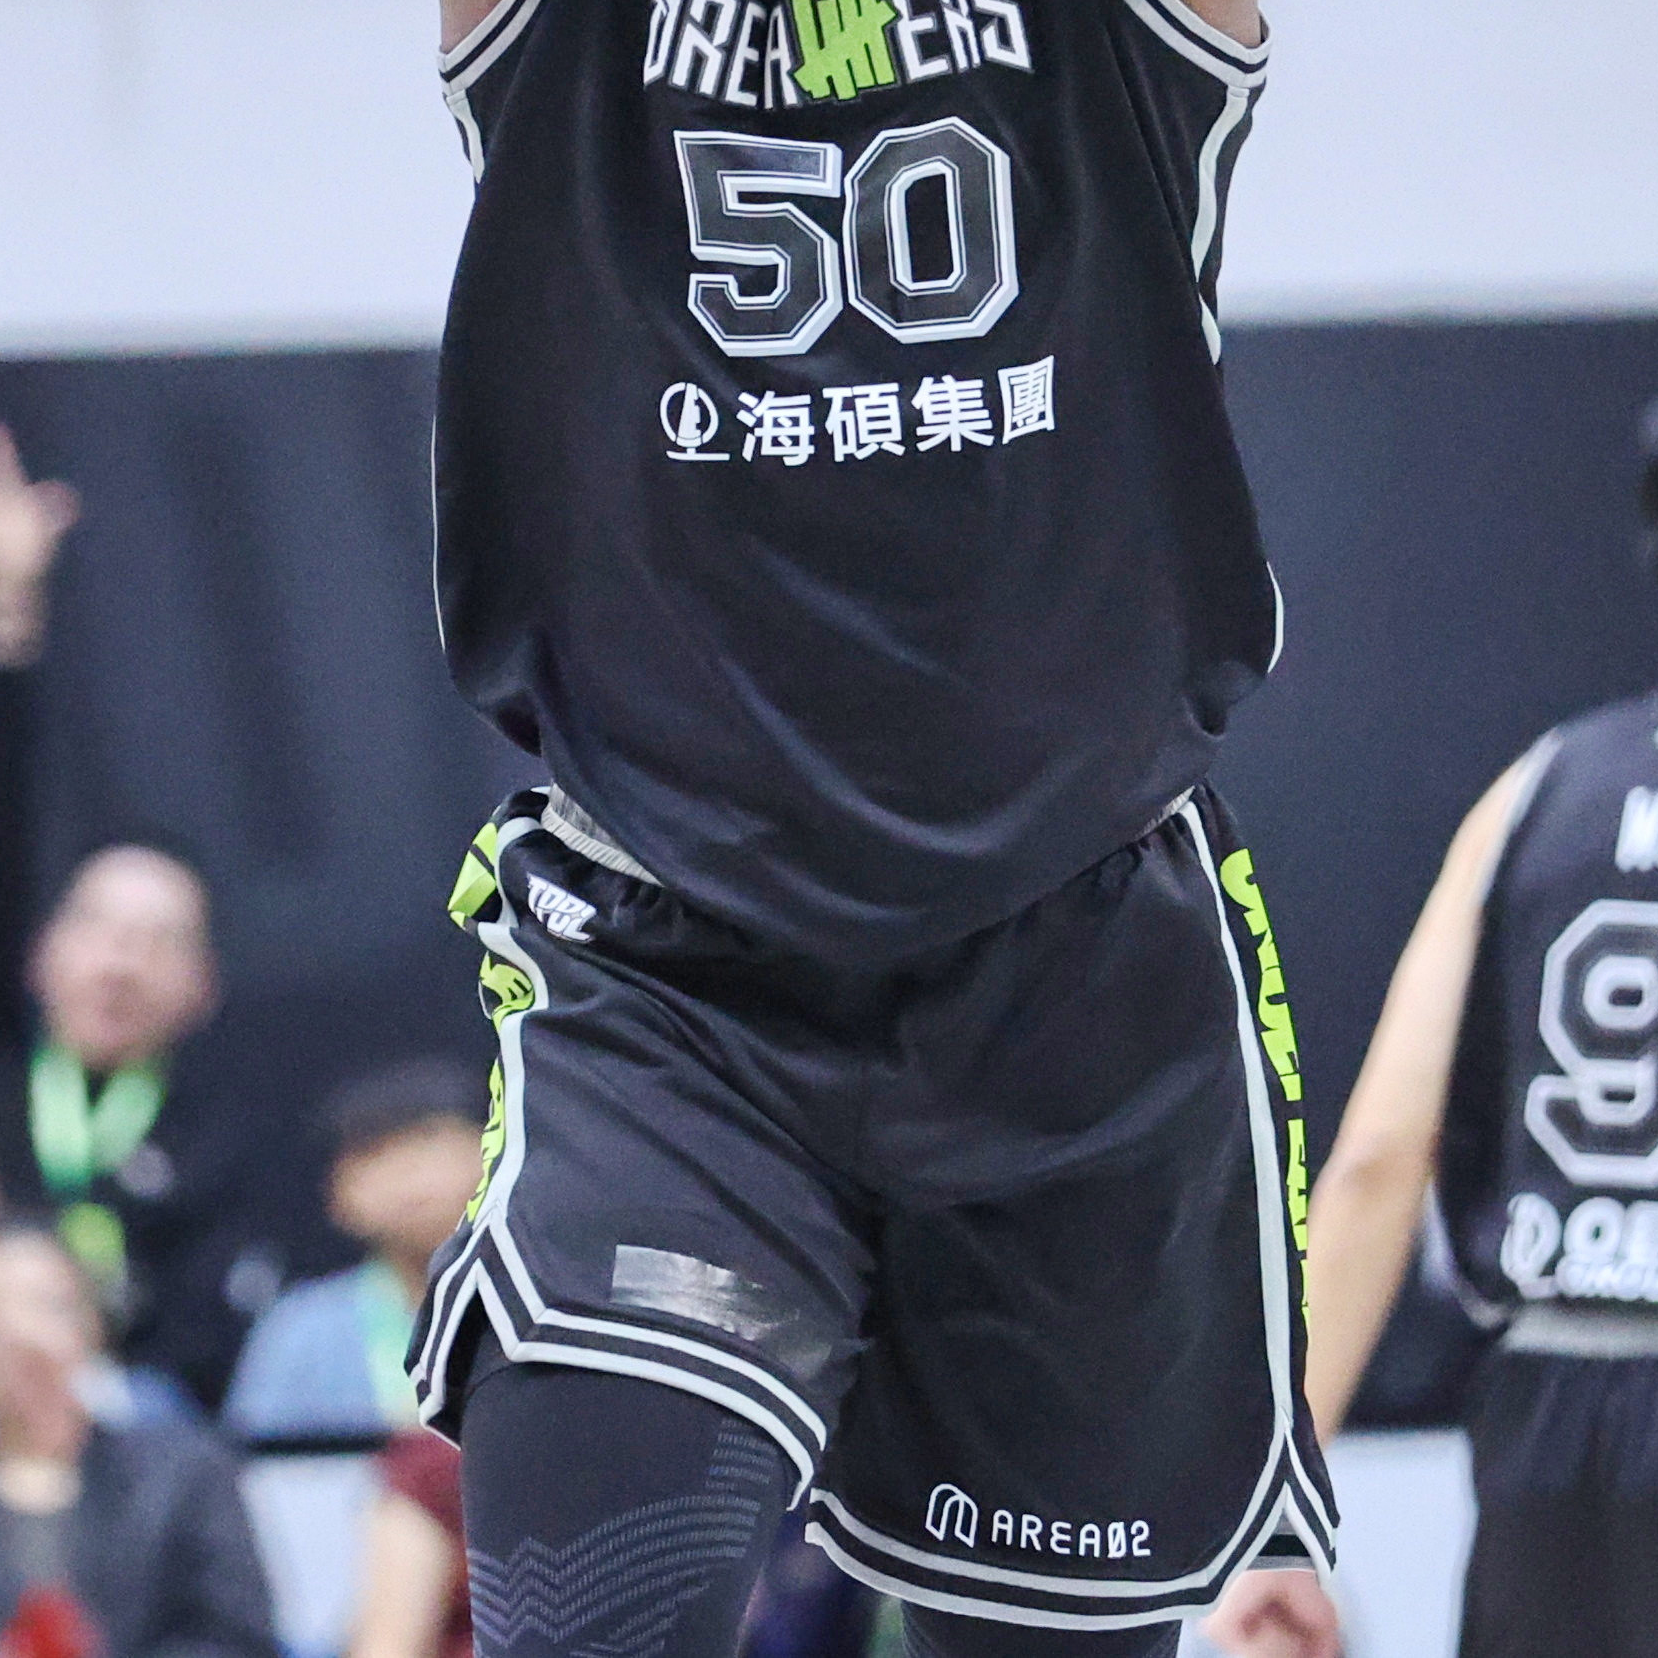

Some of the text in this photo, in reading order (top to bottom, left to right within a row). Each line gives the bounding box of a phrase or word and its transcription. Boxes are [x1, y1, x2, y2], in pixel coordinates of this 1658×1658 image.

[673, 116, 1020, 357] 50
[736, 354, 1056, 467] 海碩集團
